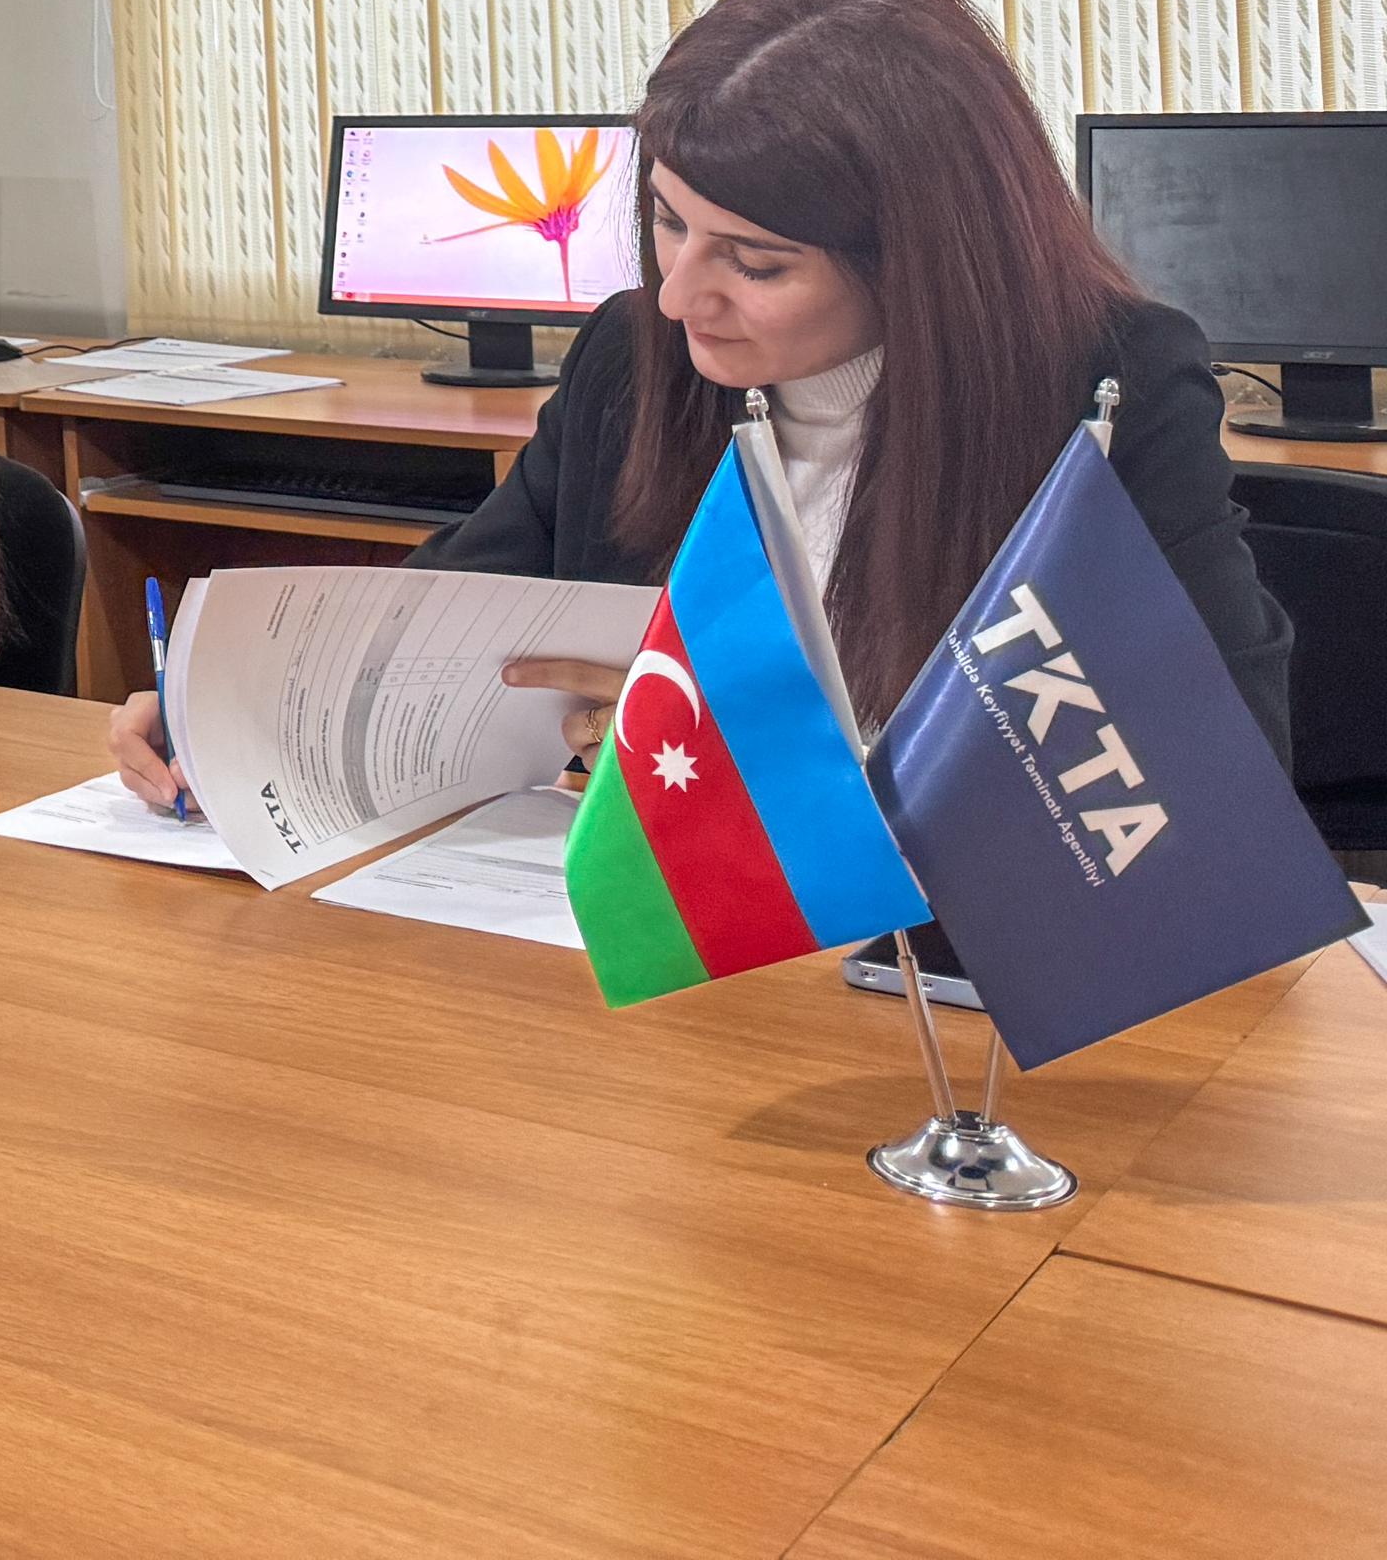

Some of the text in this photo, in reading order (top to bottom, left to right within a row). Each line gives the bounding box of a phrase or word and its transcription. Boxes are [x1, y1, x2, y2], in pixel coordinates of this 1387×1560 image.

[261, 781, 302, 854] TKTA
[946, 628, 1106, 888] Təhsildə Keyfiyyət Təminatı Agentliyi
[971, 583, 1170, 877] TKTA
